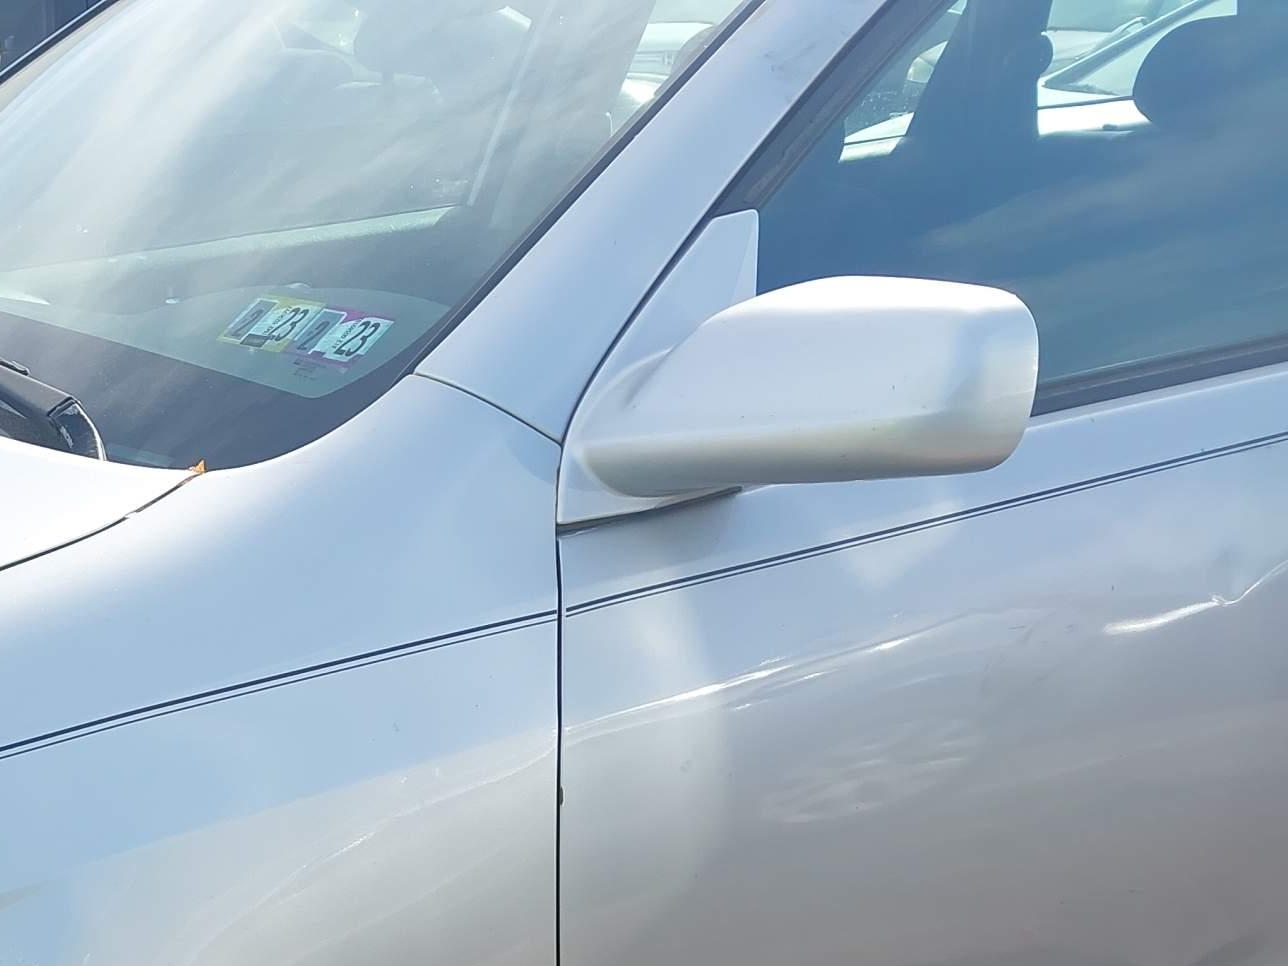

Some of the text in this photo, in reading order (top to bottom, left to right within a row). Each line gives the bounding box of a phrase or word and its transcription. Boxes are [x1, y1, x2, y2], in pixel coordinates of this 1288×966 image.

[232, 309, 265, 337] 2
[269, 307, 310, 342] 23
[297, 321, 330, 350] 2
[333, 320, 380, 356] 23
